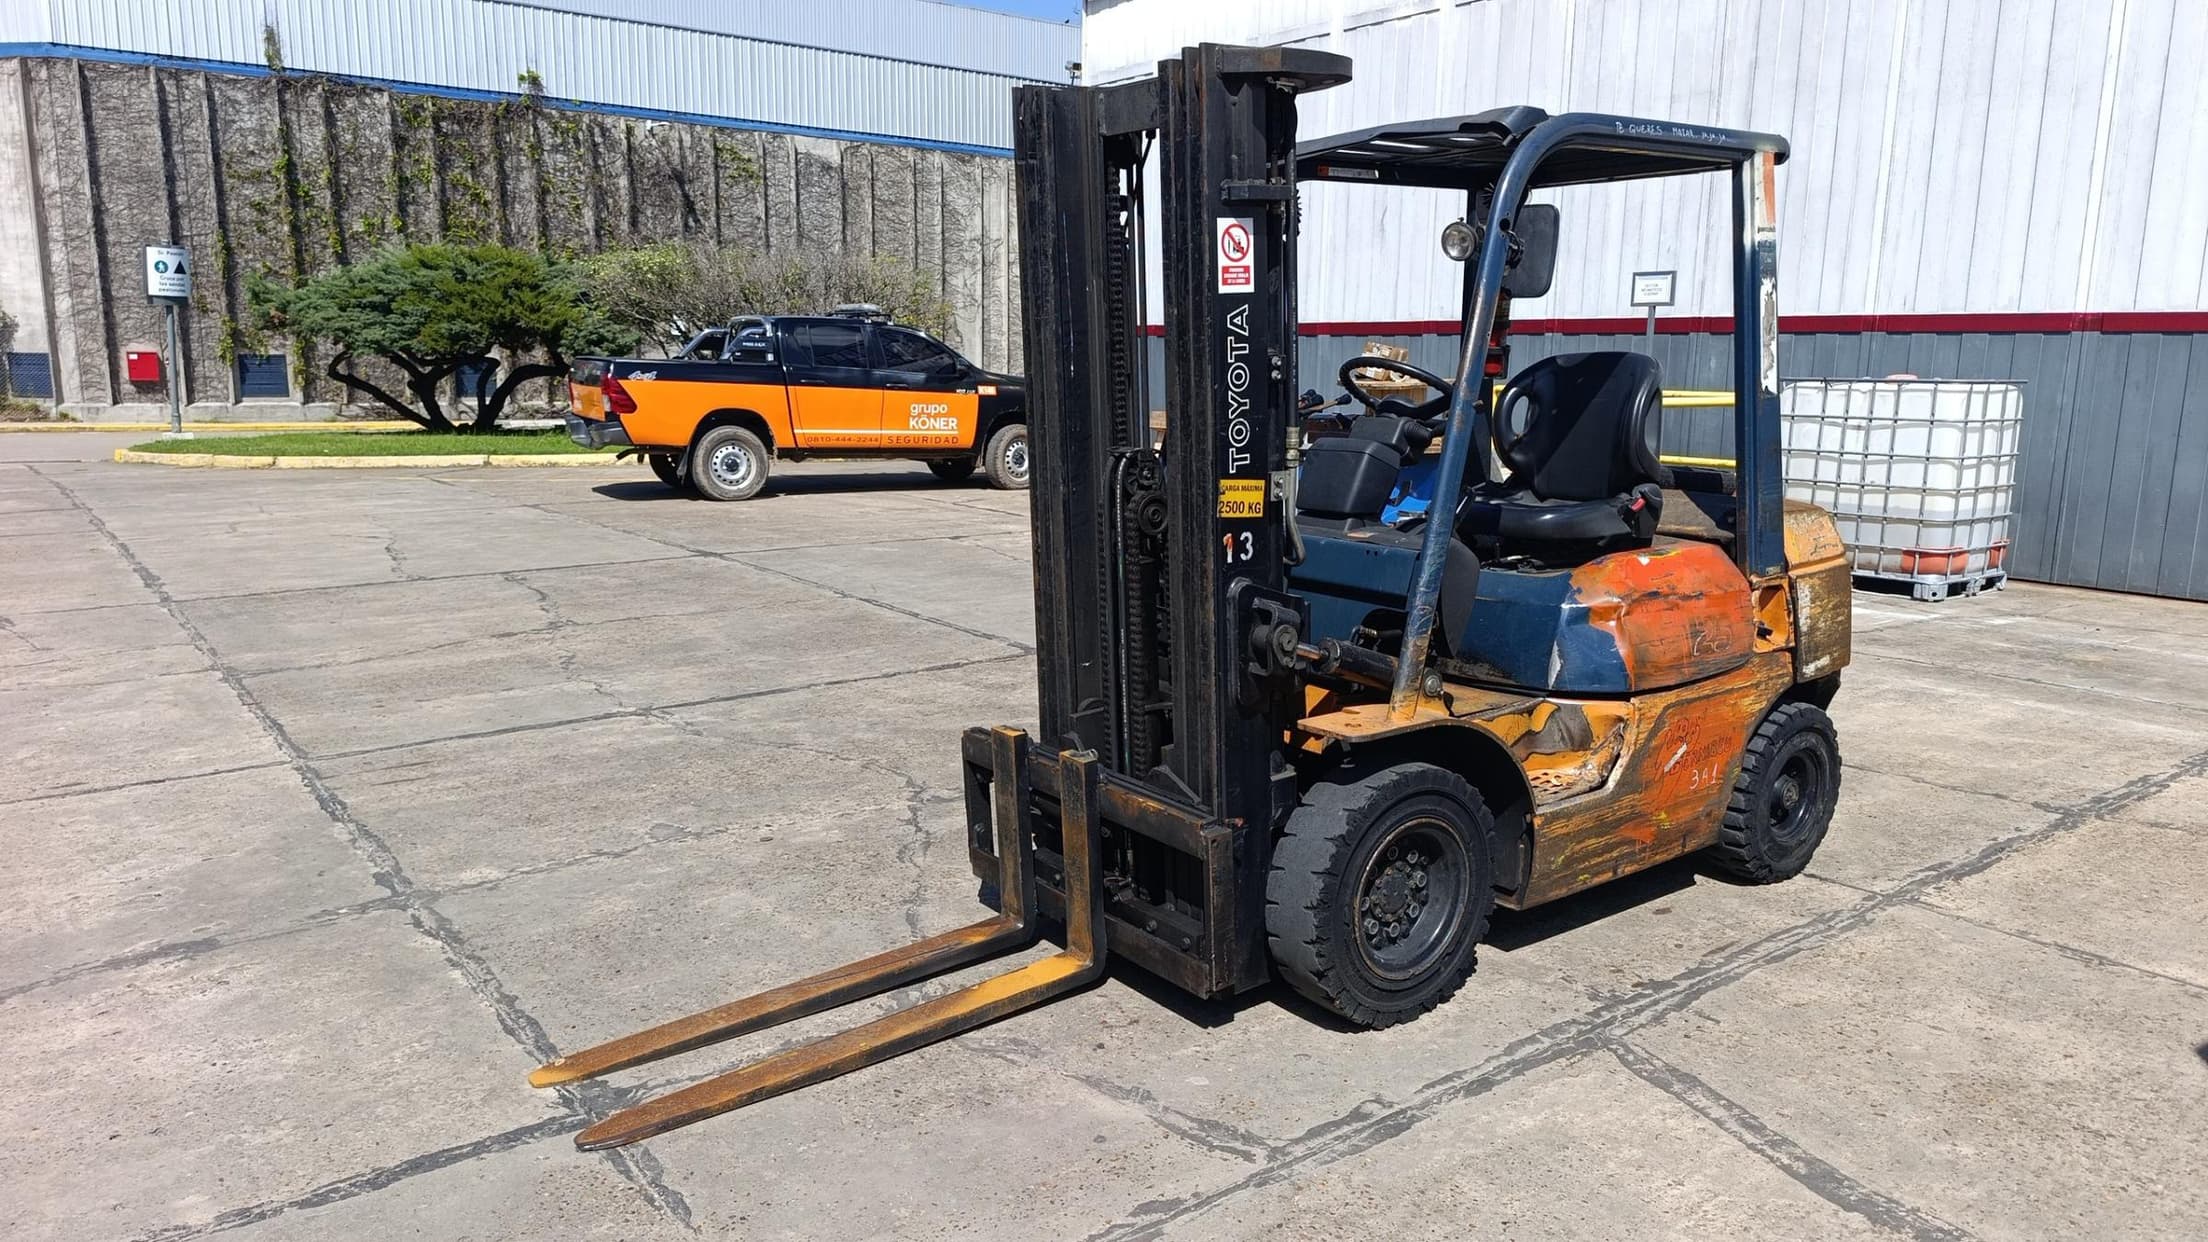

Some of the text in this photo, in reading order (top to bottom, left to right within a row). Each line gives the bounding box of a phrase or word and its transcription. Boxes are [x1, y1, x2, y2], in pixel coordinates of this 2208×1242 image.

[1226, 303, 1251, 474] TOYOTA
[910, 403, 948, 416] grupo
[887, 436, 959, 445] SEGURIDAD
[1218, 501, 1262, 514] 2500 KG
